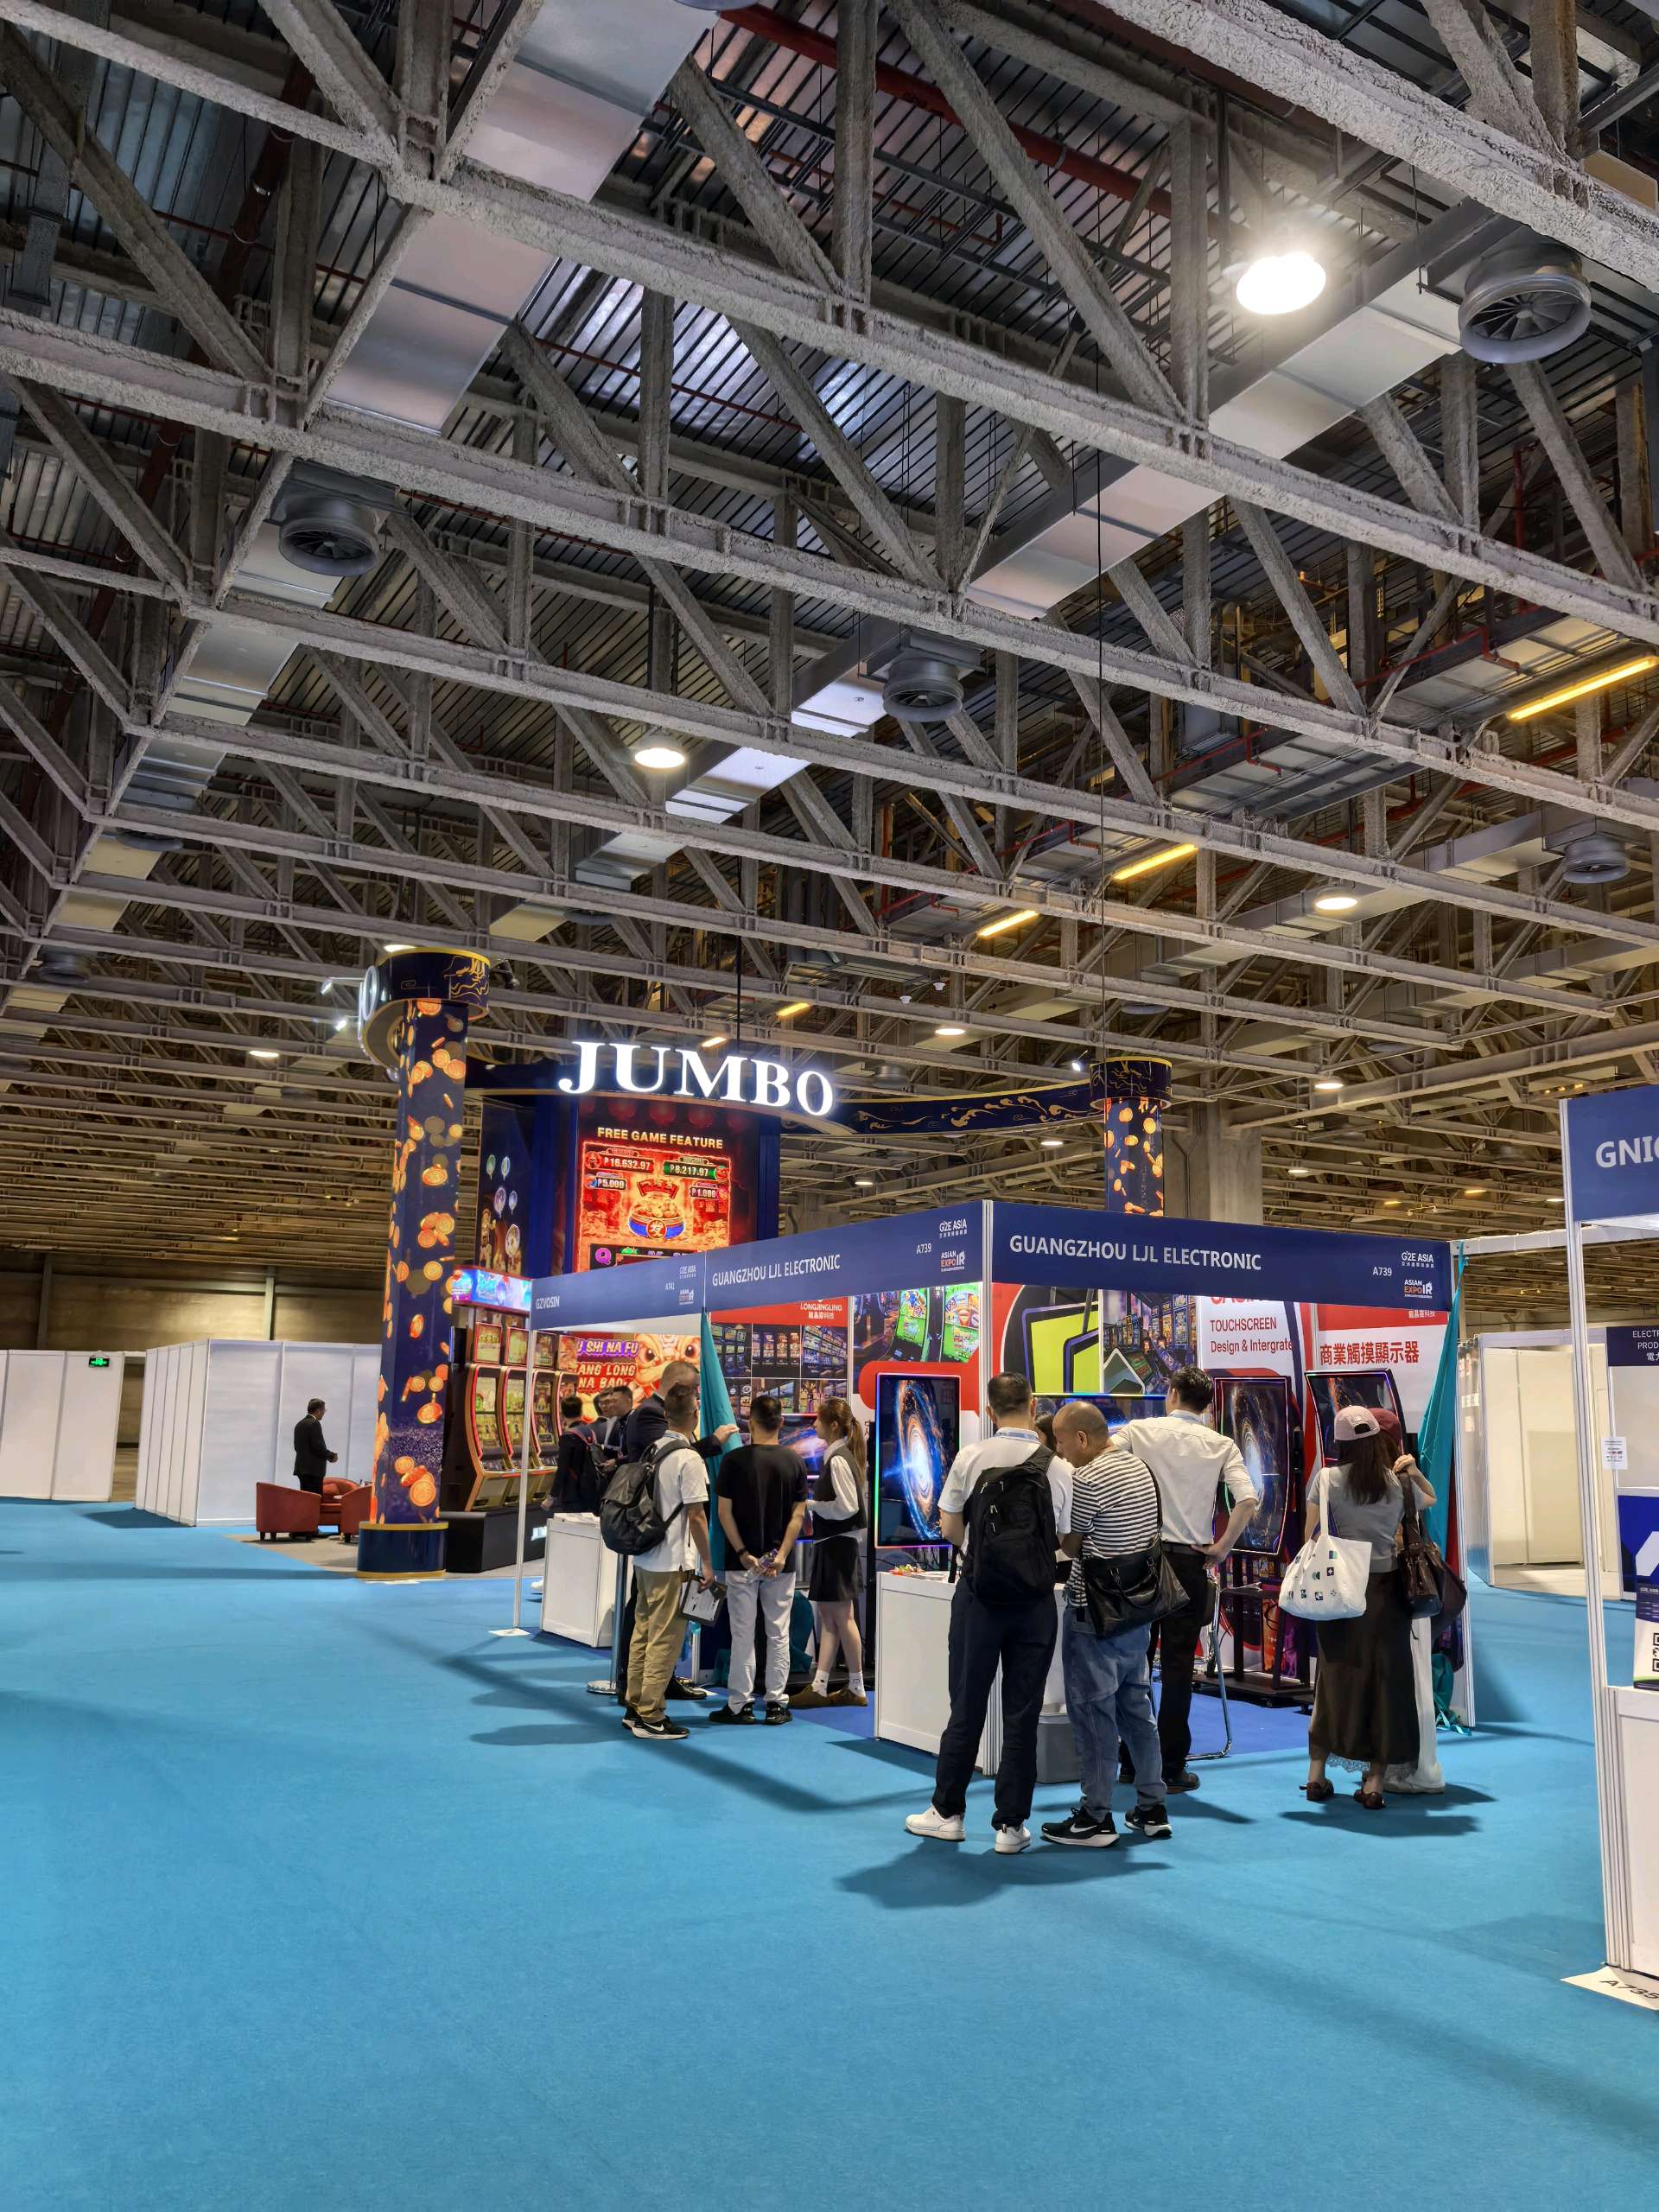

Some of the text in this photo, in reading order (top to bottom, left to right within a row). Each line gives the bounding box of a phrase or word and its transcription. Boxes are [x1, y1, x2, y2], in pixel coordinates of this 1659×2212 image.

[558, 1041, 834, 1116] JUMBO
[597, 1126, 723, 1149] FREE GAME FEATURE
[1595, 1135, 1659, 1168] GNI
[939, 1218, 967, 1232] G2E ASIA
[916, 1243, 932, 1255] A739
[1009, 1235, 1262, 1271] GUANGZHOU LJL ELECTRONIC
[1401, 1251, 1434, 1262] G2E ASIA
[712, 1254, 841, 1286] GUANGZHOU LJL ELECTRONIC
[1372, 1266, 1392, 1276] A739
[535, 1295, 560, 1310] GZVOSIN
[800, 1302, 843, 1312] LONGJINGLING
[1210, 1316, 1277, 1332] TOUCHSCREEN
[586, 1340, 604, 1353] SHI
[606, 1341, 622, 1354] NA
[624, 1342, 639, 1355] FU
[1211, 1339, 1239, 1355] Design
[1242, 1338, 1248, 1351] &
[1319, 1340, 1420, 1366] 商業觸摸顯示器
[577, 1363, 637, 1376] ANG LONG
[578, 1376, 595, 1389] NA
